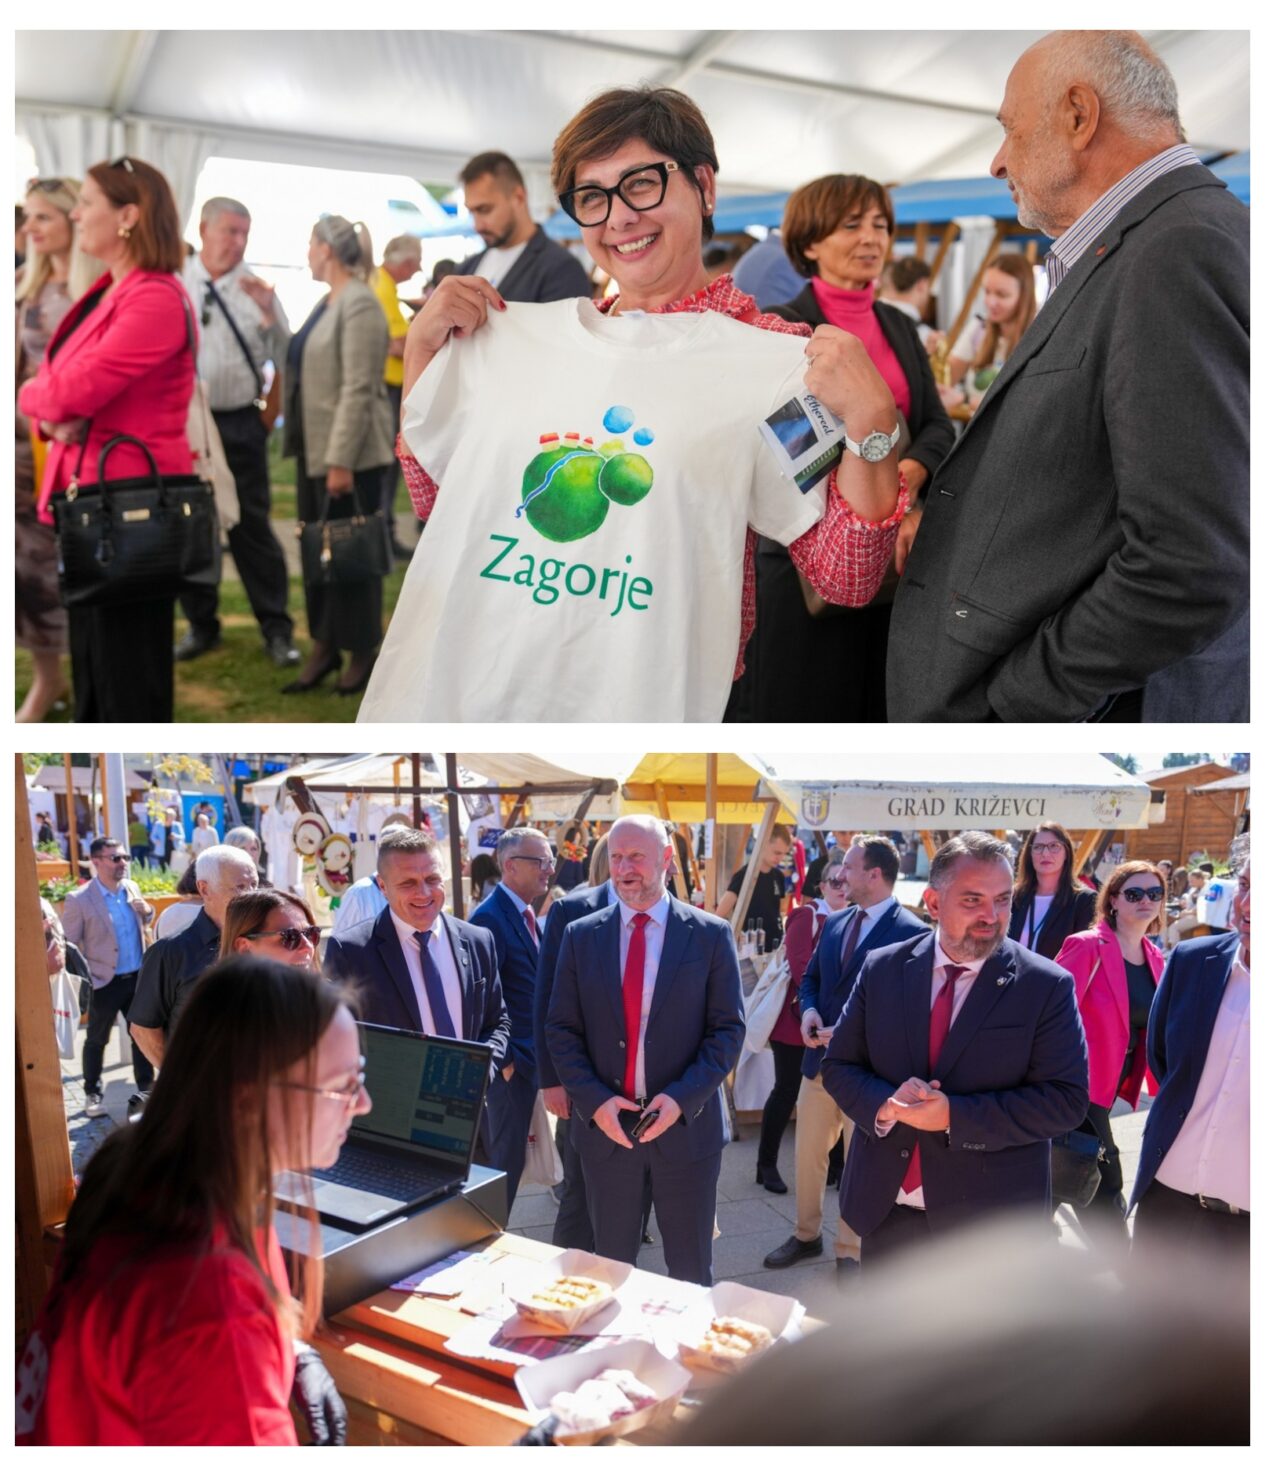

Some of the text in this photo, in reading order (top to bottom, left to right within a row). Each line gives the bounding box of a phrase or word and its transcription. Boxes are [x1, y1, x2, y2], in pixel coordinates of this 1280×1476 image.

[480, 534, 654, 617] Zagorje
[887, 794, 1047, 816] GRAD KRIŽEVCI
